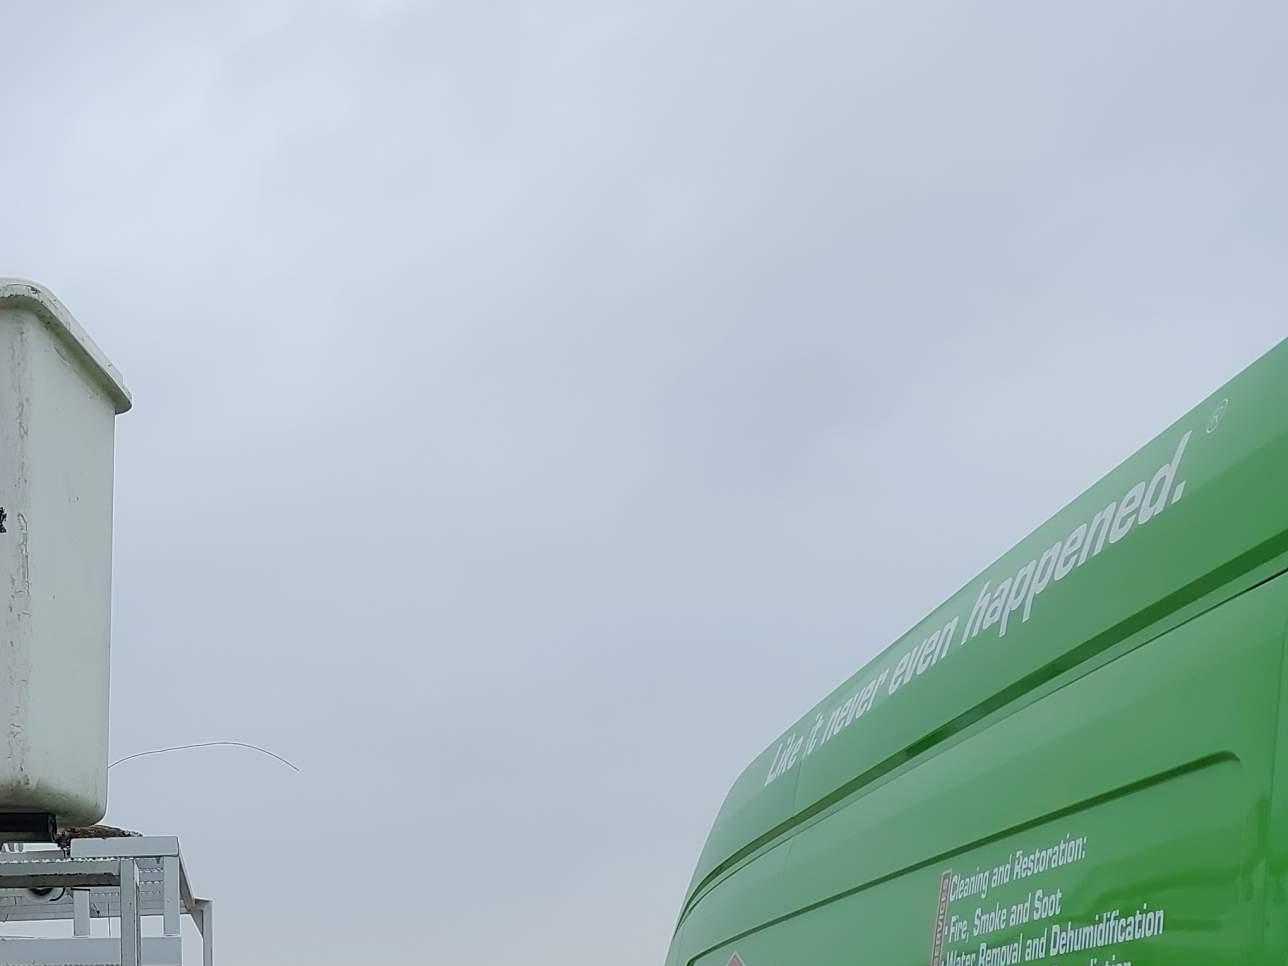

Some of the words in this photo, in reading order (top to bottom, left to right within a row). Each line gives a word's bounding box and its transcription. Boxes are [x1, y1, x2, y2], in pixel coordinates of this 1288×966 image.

[764, 733, 803, 787] Like
[803, 712, 824, 760] it
[821, 670, 888, 744] never
[888, 616, 959, 695] even
[961, 430, 1192, 645] happened.
[949, 866, 990, 902] Cleaning
[991, 854, 1013, 888] and
[1013, 833, 1087, 880] Restoration:
[948, 914, 969, 943] Fire,
[973, 902, 1007, 936] Smoke
[1010, 893, 1031, 926] and
[1034, 888, 1063, 920] Soot
[1025, 927, 1047, 961] and
[1050, 903, 1164, 957] Dehumidification
